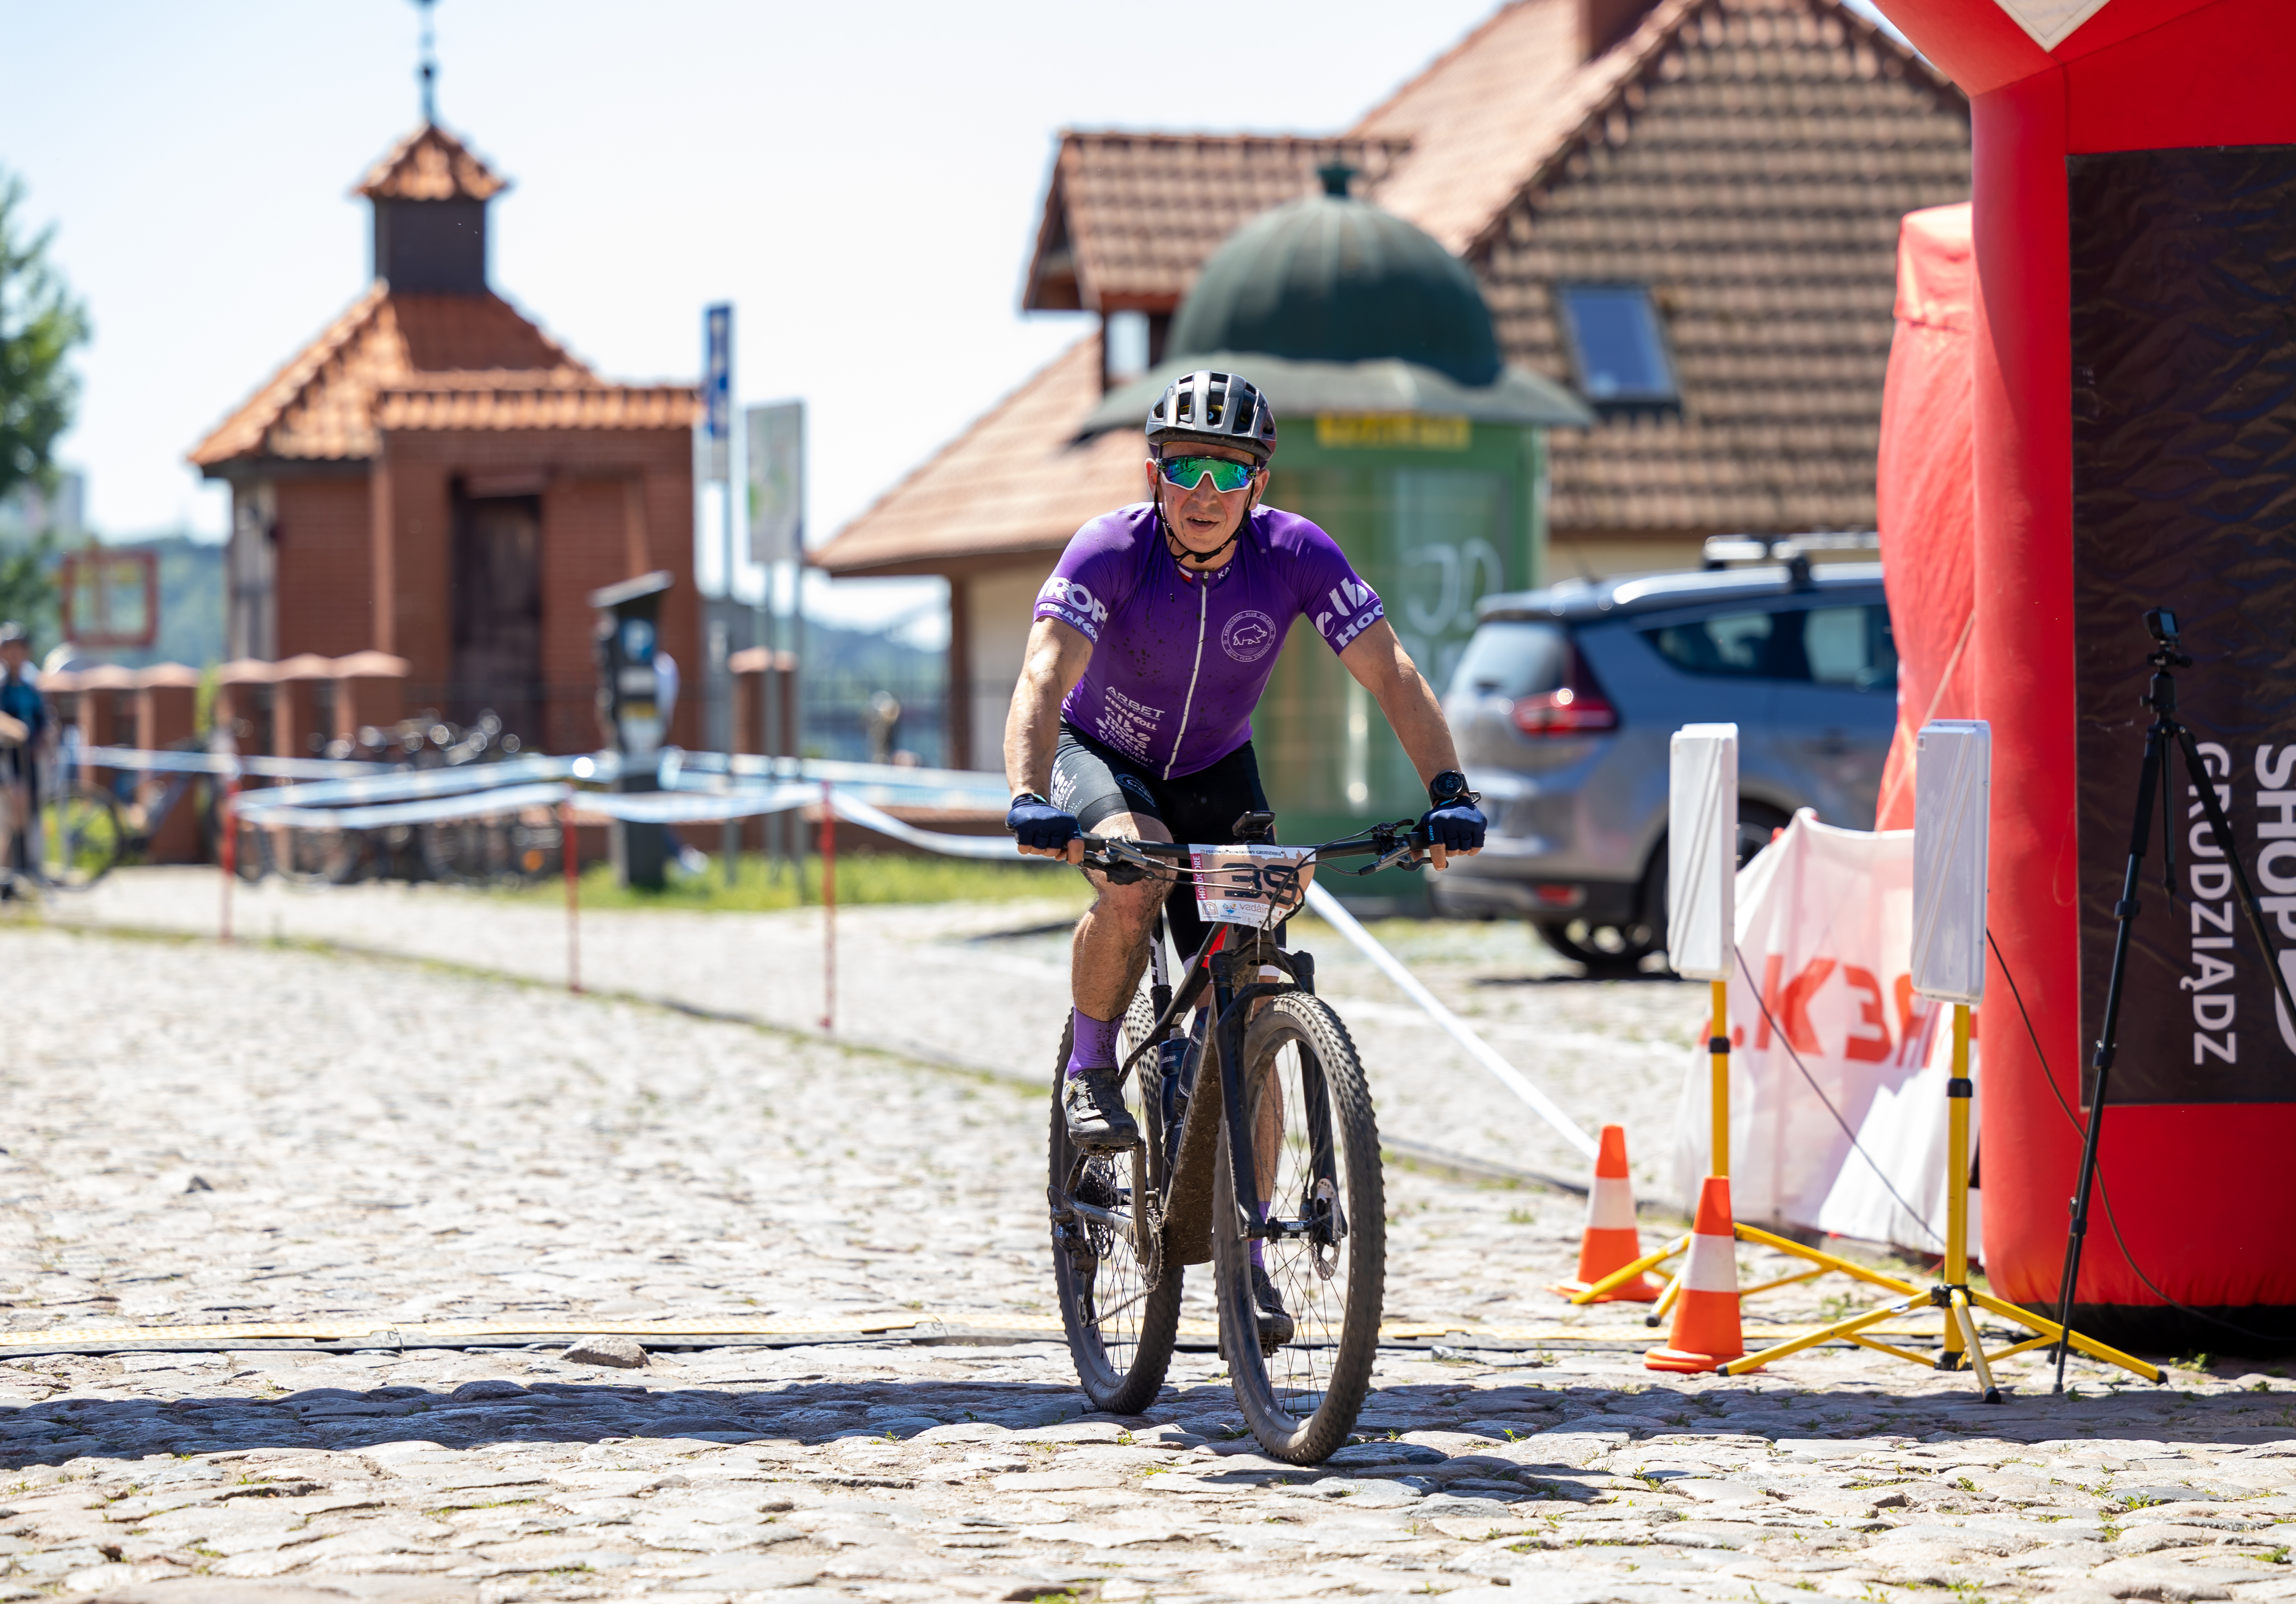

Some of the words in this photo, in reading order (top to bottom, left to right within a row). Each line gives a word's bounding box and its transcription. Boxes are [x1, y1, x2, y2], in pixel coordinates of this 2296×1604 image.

[1217, 562, 1232, 579] KA
[1039, 602, 1098, 644] KERAKO
[1259, 614, 1274, 631] KOLARSKI
[1316, 577, 1379, 637] elb
[1335, 602, 1384, 648] HOC
[1105, 694, 1157, 731] KERAKOLL
[1106, 686, 1166, 718] ARBET
[1106, 712, 1147, 749] TROPS
[2255, 744, 2296, 940] SHOP
[1221, 863, 1299, 905] 39
[2180, 742, 2238, 1066] GRUDZIĄDZ
